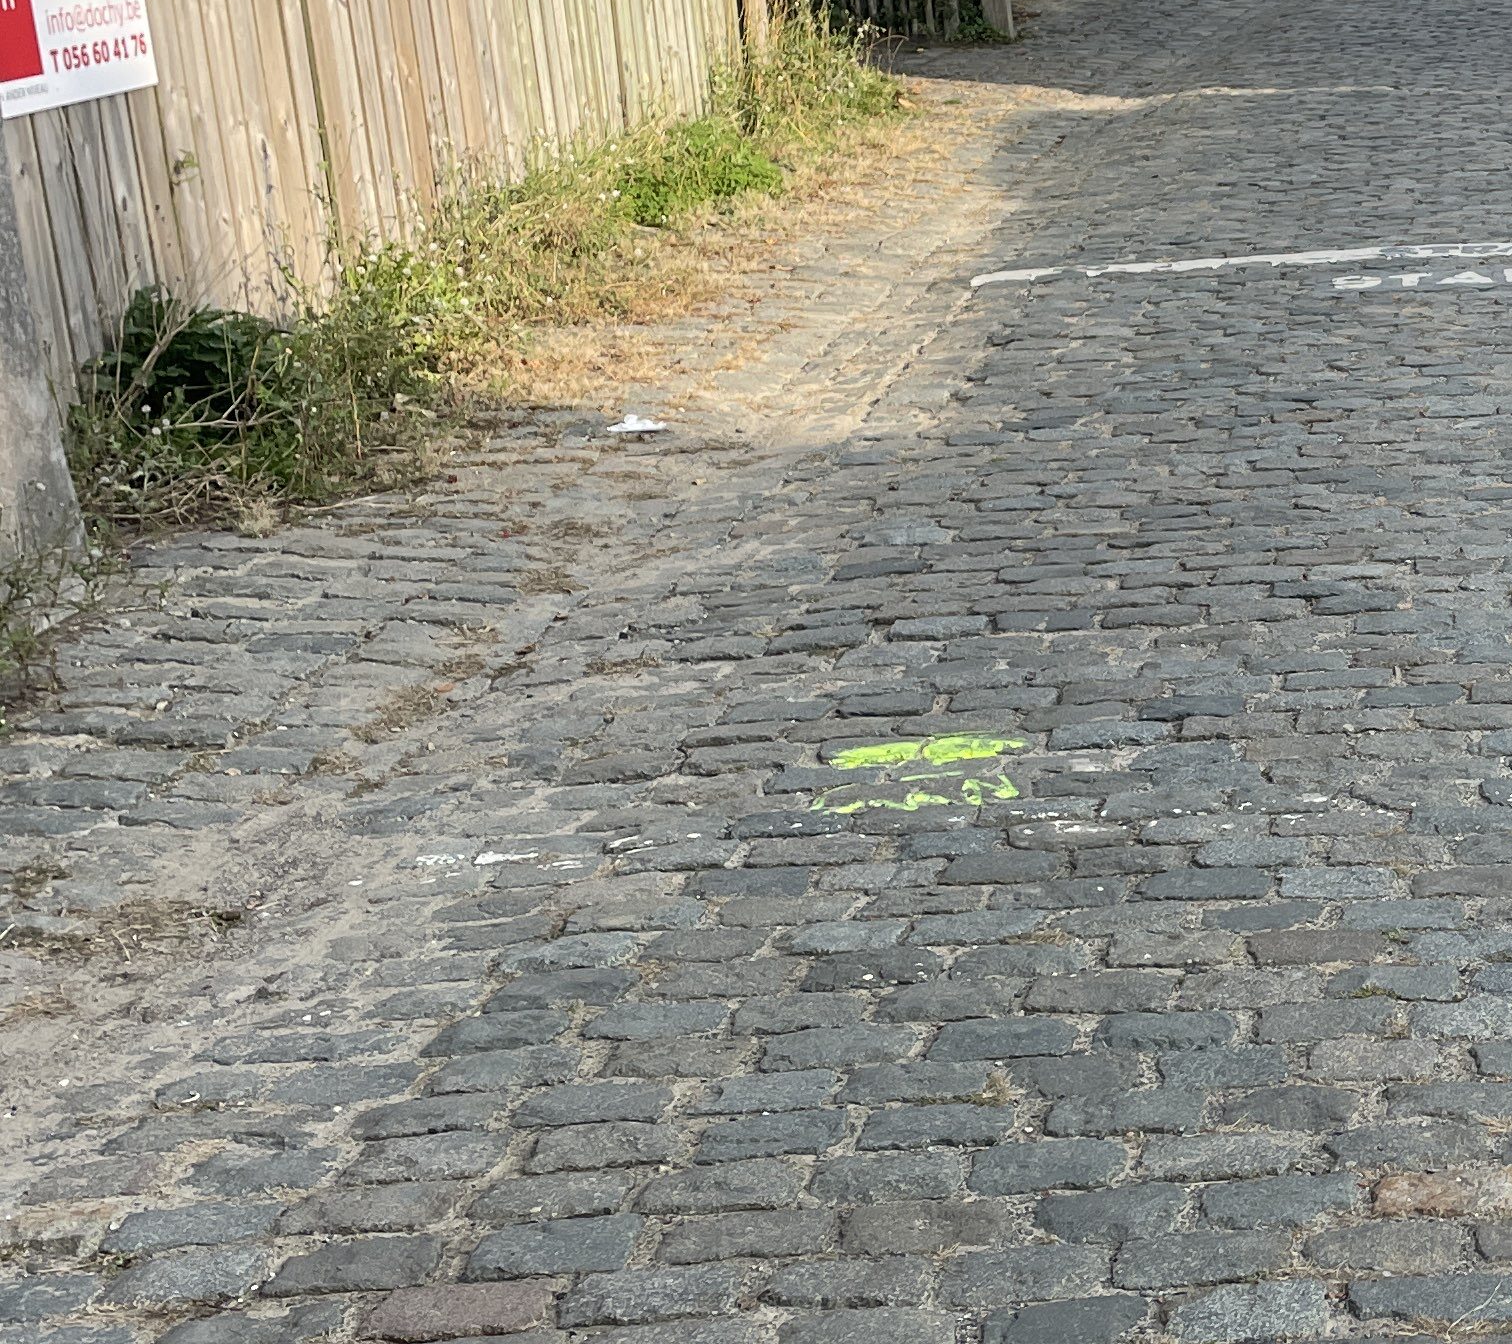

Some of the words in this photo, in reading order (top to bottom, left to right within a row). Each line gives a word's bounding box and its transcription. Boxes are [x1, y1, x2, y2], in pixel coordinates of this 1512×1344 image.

[49, 48, 59, 73] T
[62, 43, 90, 70] 056
[92, 40, 110, 64] 60
[113, 37, 129, 60] 41
